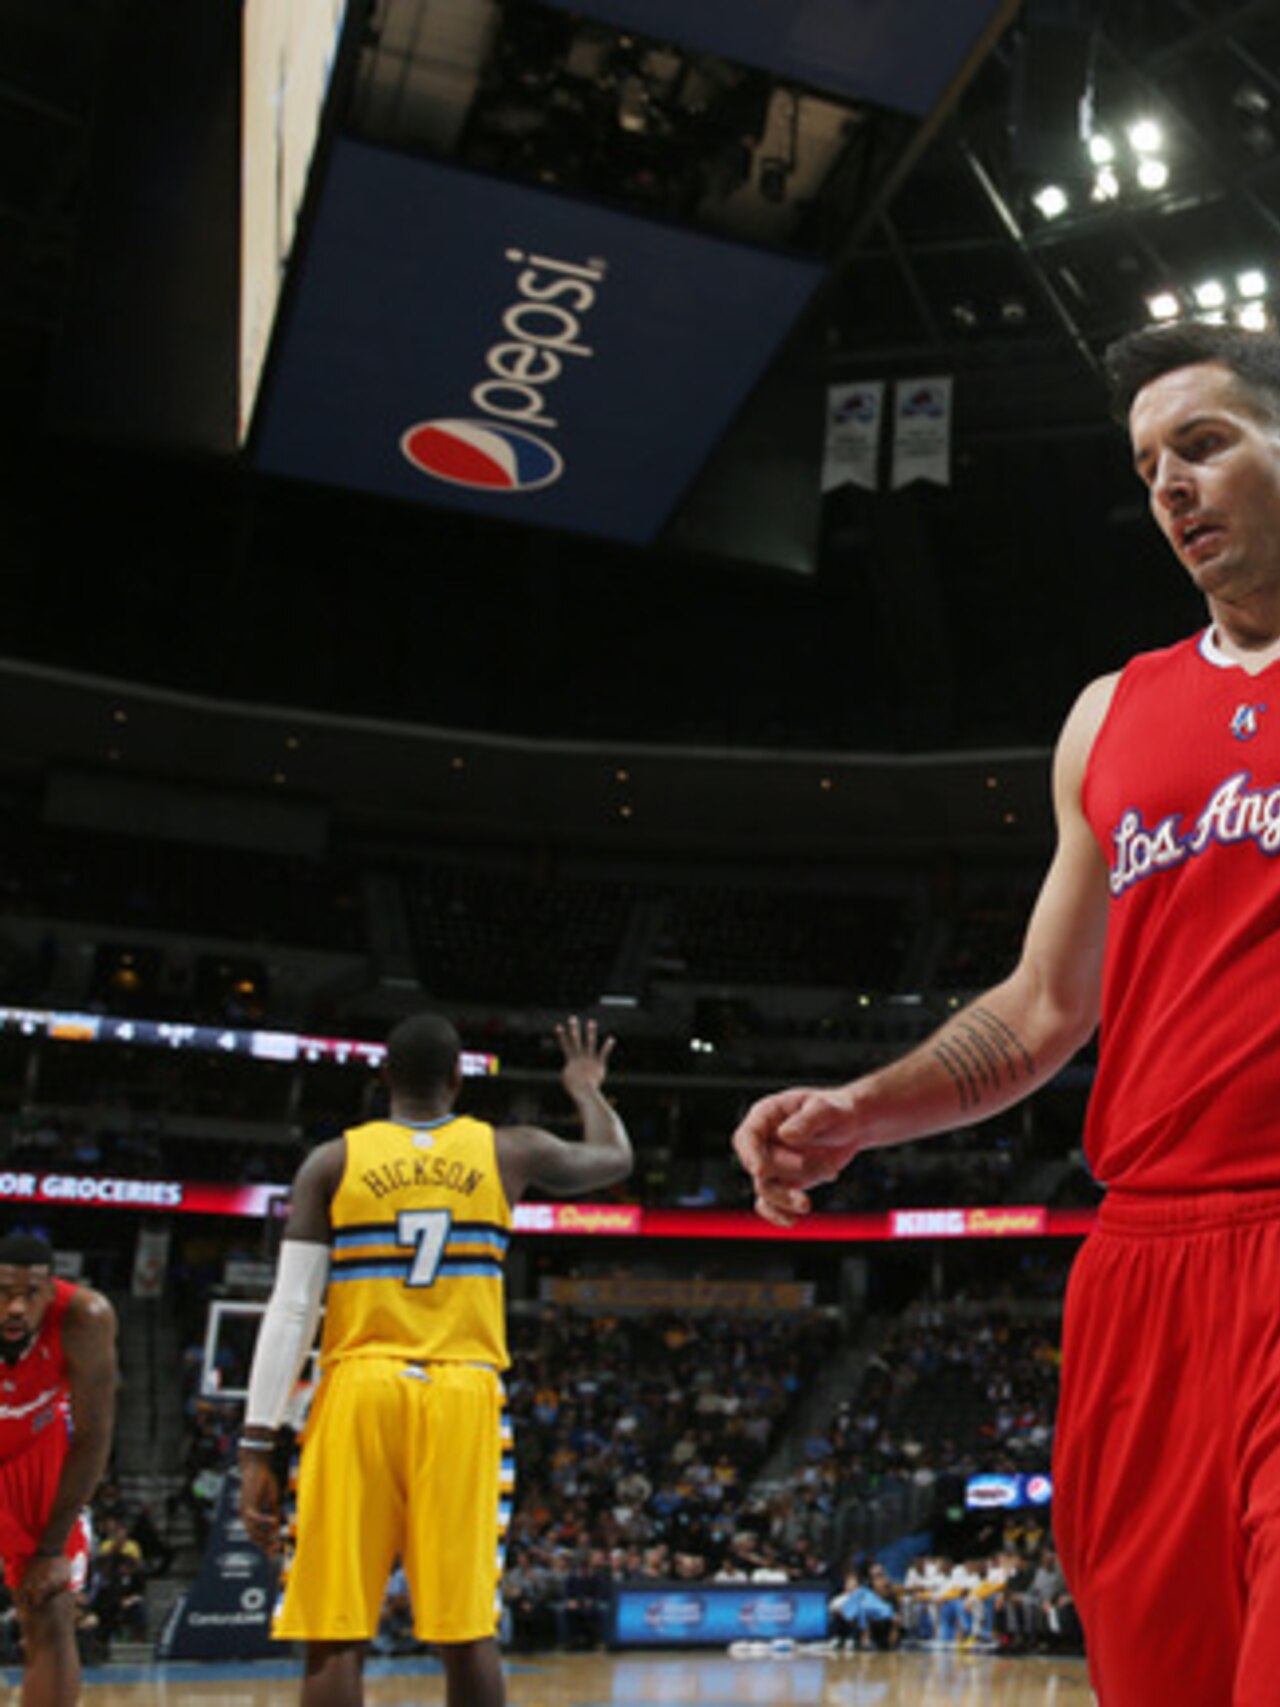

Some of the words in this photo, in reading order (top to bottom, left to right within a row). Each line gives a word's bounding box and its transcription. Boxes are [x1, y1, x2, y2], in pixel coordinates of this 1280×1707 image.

[471, 248, 602, 427] pepsi
[1109, 807, 1191, 896] Los
[40, 1174, 183, 1206] GROCERIES
[362, 1156, 485, 1199] HICKSON
[396, 1208, 452, 1288] 7
[896, 1211, 964, 1234] KING
